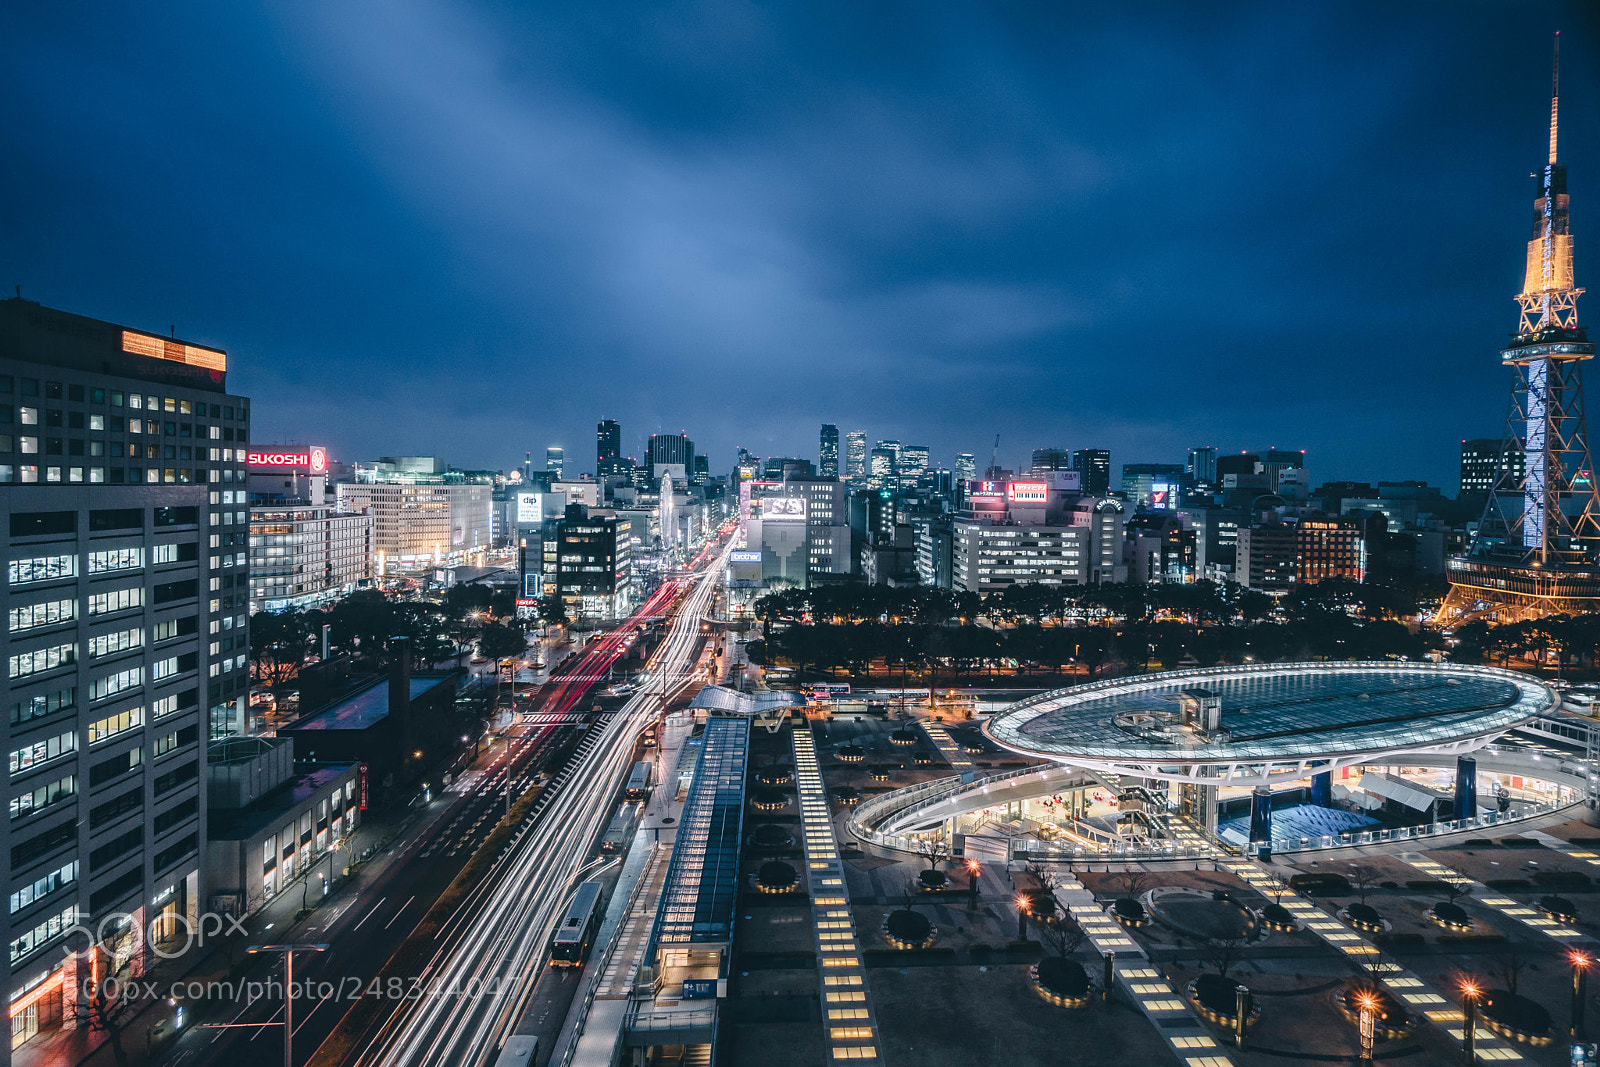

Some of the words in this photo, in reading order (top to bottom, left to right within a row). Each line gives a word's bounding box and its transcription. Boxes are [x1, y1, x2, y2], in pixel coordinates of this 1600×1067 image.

[248, 454, 308, 465] SUKOSHI
[523, 497, 537, 505] dip
[734, 552, 759, 560] brother
